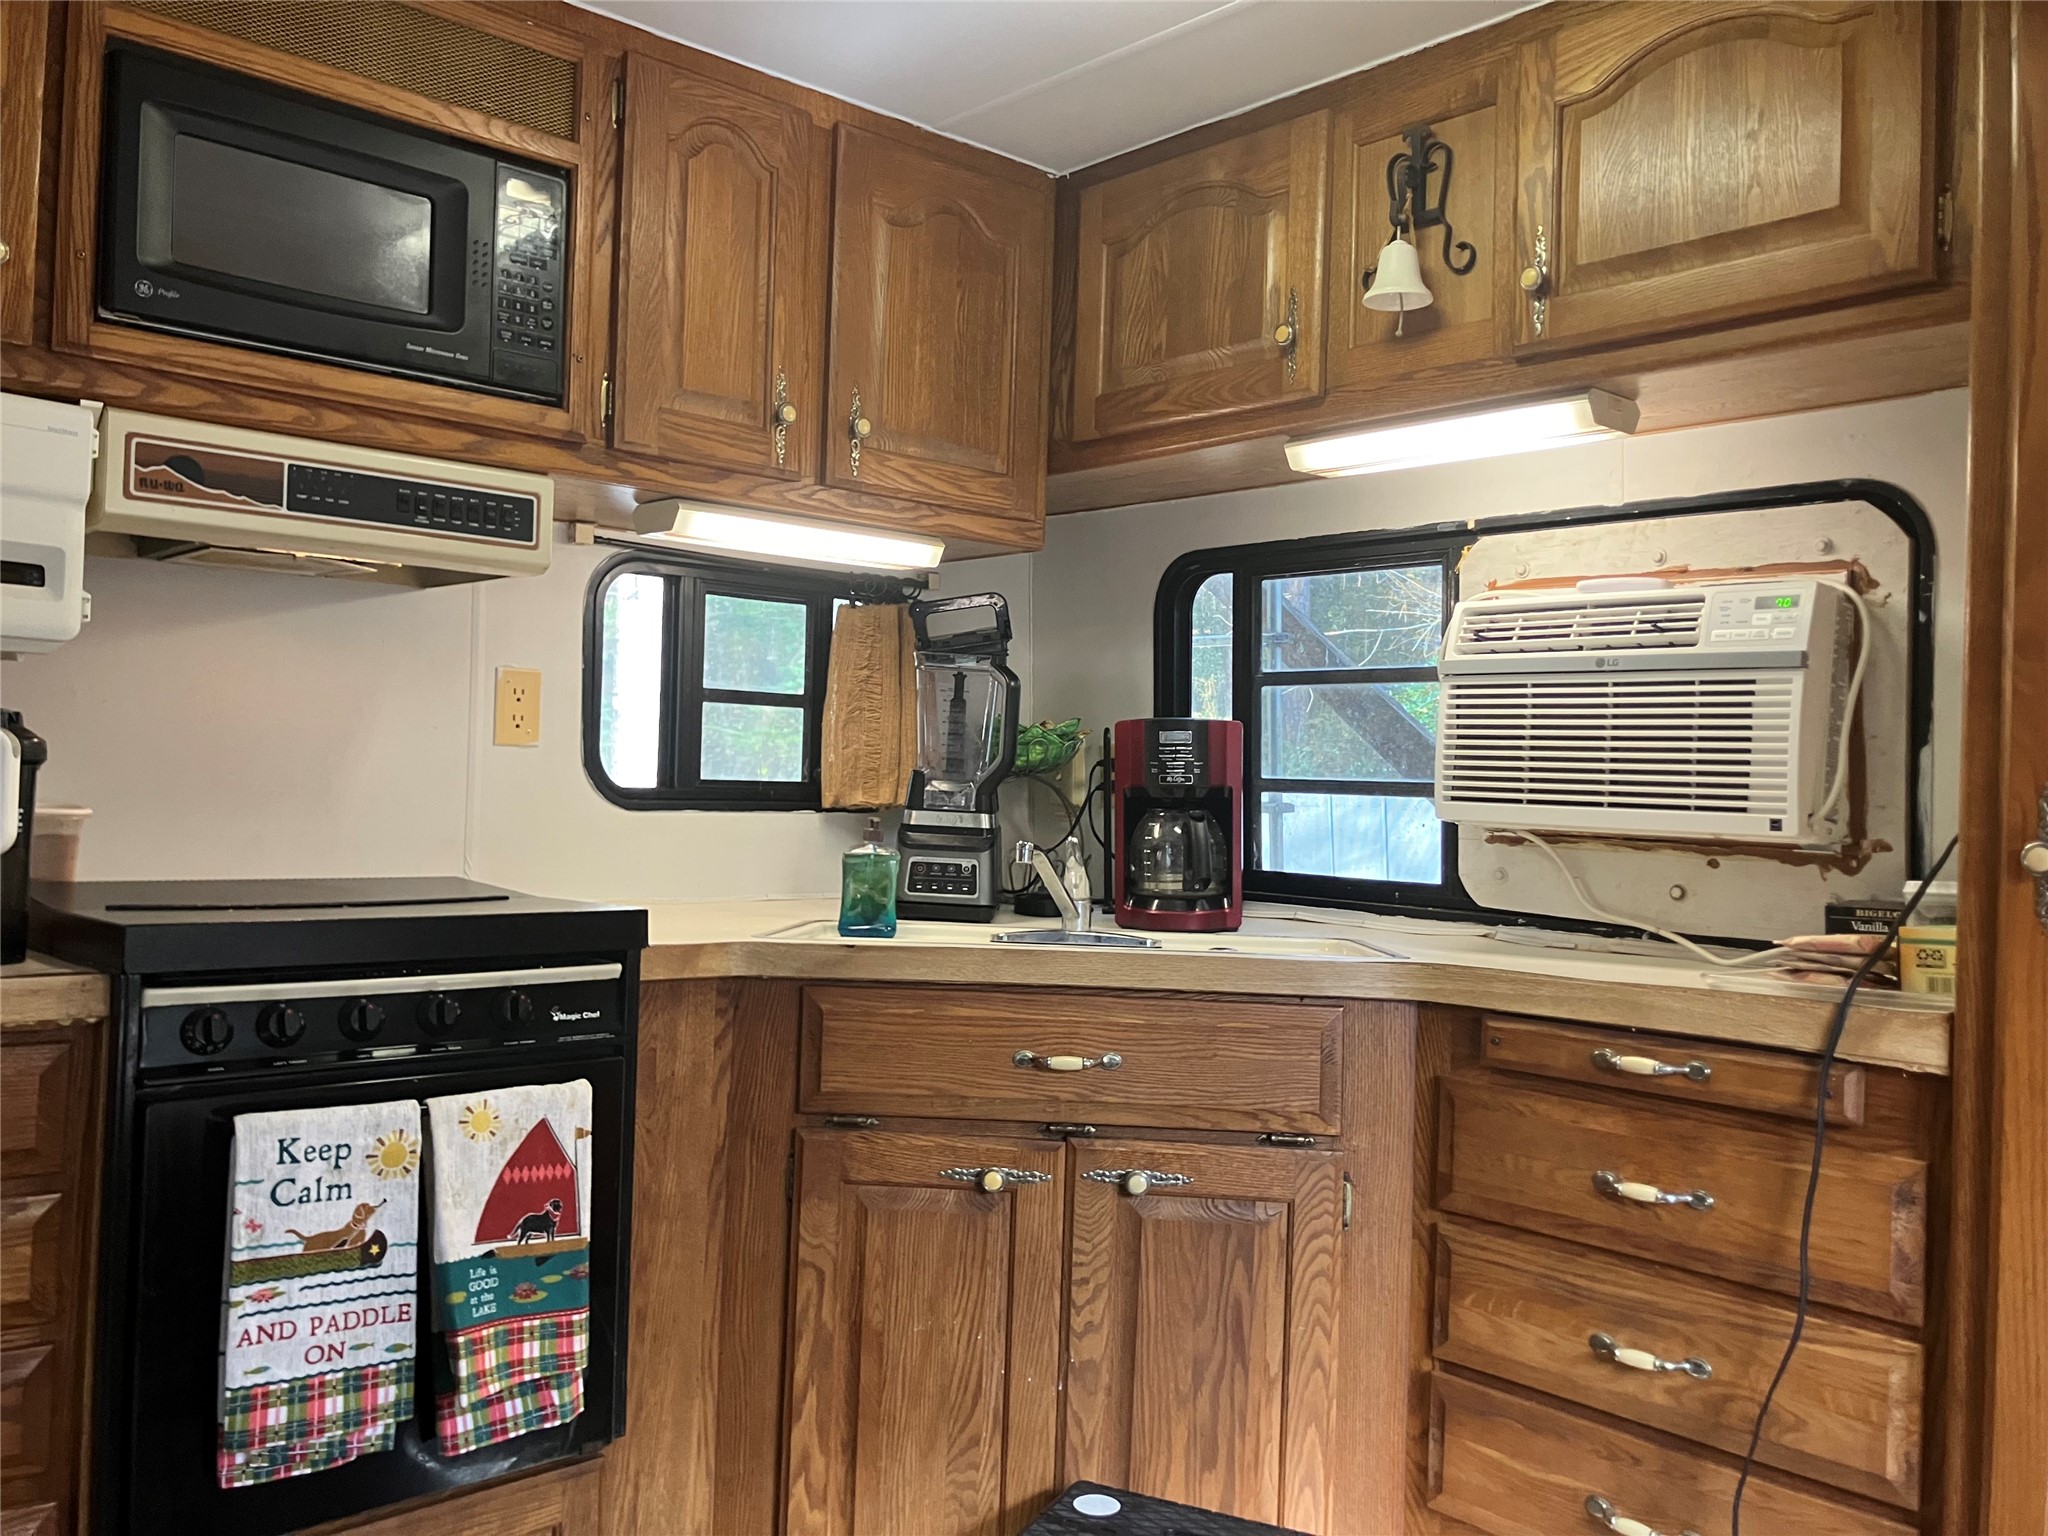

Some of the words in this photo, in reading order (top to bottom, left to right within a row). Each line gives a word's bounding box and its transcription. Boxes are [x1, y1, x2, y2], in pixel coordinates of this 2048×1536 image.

[1606, 658, 1619, 667] LG
[1851, 920, 1889, 933] Vanilla
[558, 1011, 582, 1021] Magic
[582, 1010, 600, 1019] Chef
[276, 1137, 352, 1169] Keep
[270, 1176, 353, 1207] Calm
[469, 1267, 486, 1279] Life
[489, 1265, 497, 1275] is
[468, 1277, 499, 1292] GOOD
[470, 1297, 478, 1305] at
[480, 1292, 495, 1302] the
[472, 1302, 497, 1318] LAKE
[236, 1320, 297, 1349] AND
[310, 1303, 412, 1337] PADDLE
[304, 1341, 346, 1365] ON
